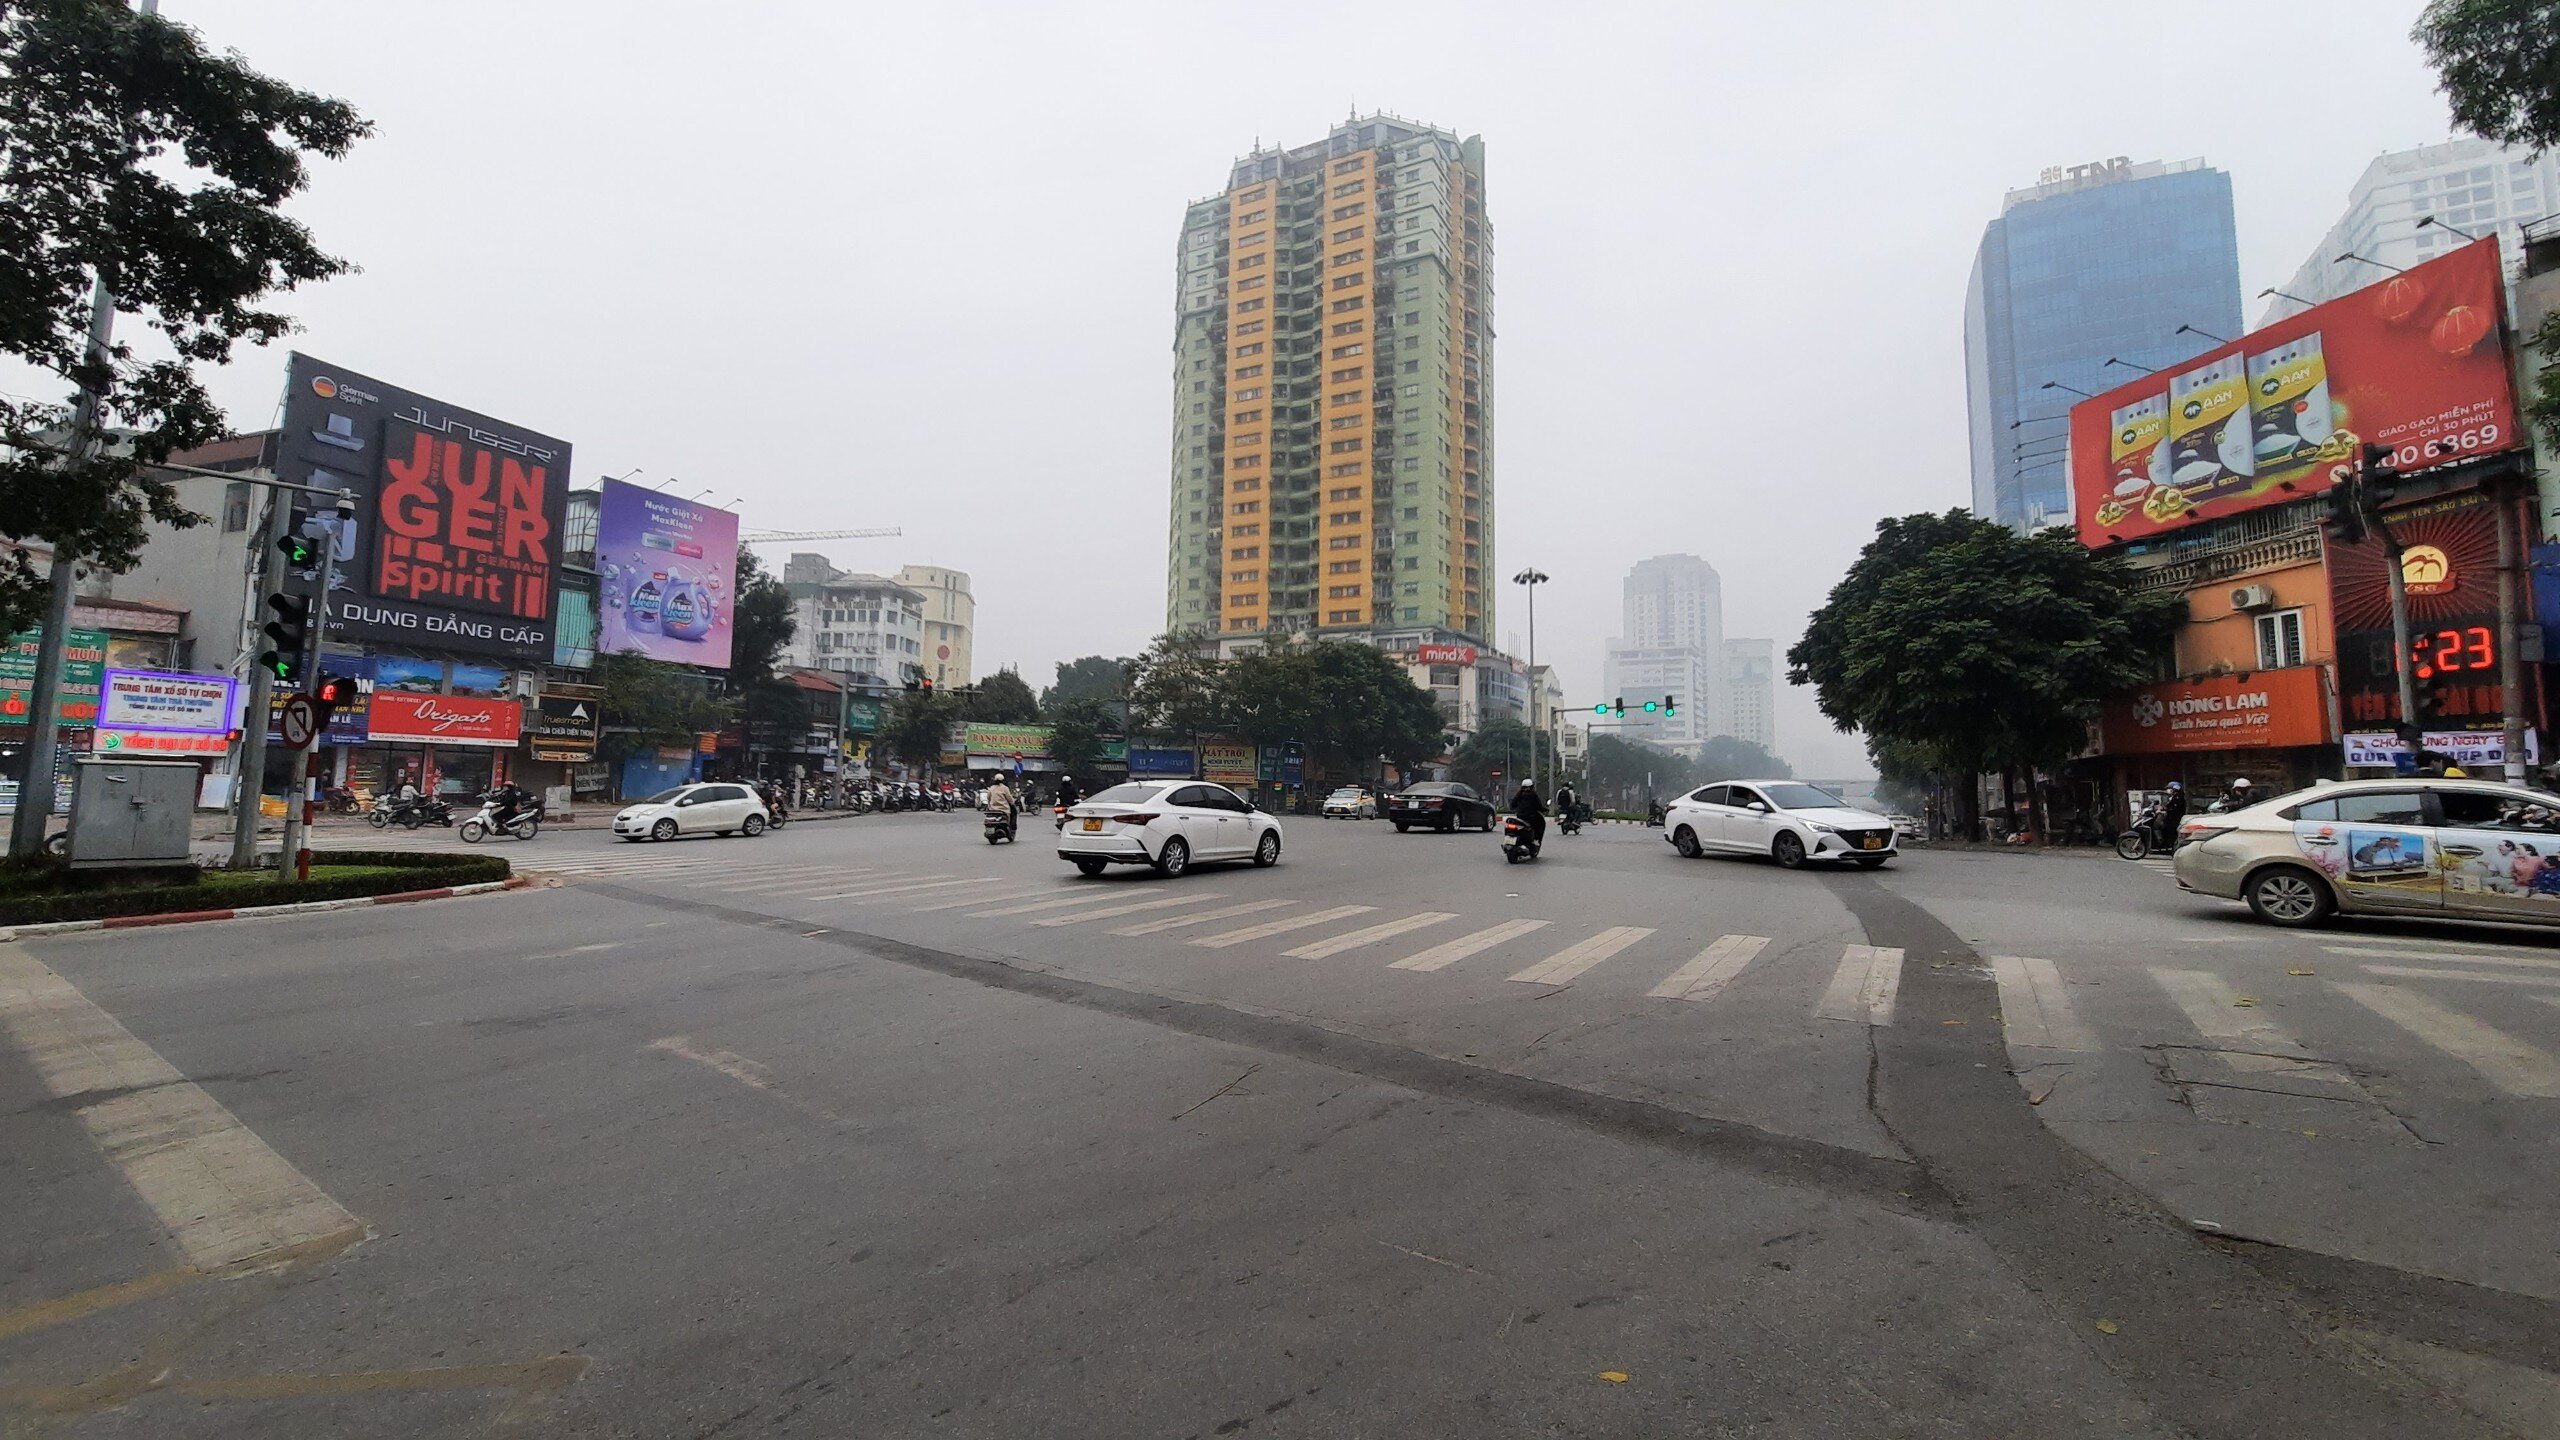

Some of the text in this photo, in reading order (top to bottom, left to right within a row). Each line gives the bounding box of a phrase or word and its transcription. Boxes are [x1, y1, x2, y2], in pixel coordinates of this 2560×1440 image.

[2281, 367, 2310, 386] AAN
[339, 391, 363, 406] Spirit
[340, 384, 379, 403] German
[2203, 391, 2233, 408] AAN
[2378, 425, 2407, 439] GIAO
[2439, 406, 2470, 421] MIỄN
[2472, 397, 2495, 412] PHÍ
[394, 407, 551, 463] JUNGER
[2135, 422, 2160, 437] AAN
[2419, 424, 2440, 438] CHỈ
[2443, 421, 2459, 432] 30
[2424, 424, 2499, 459] 6869
[645, 500, 670, 514] Nước
[671, 601, 694, 612] Max
[343, 603, 417, 628] DỤNG
[426, 612, 493, 639] ĐẲNG
[500, 625, 544, 645] CẤP
[1426, 647, 1468, 661] mindX
[113, 683, 141, 692] TRUNG
[145, 684, 162, 694] TÂM
[177, 686, 189, 696] SỐ
[201, 690, 223, 700] CHỌN
[2169, 690, 2269, 715] HỒNG LAM
[413, 699, 491, 732] Origato
[2171, 718, 2194, 730] Tinh
[2195, 717, 2217, 729] hoa
[2245, 712, 2269, 728] Việt
